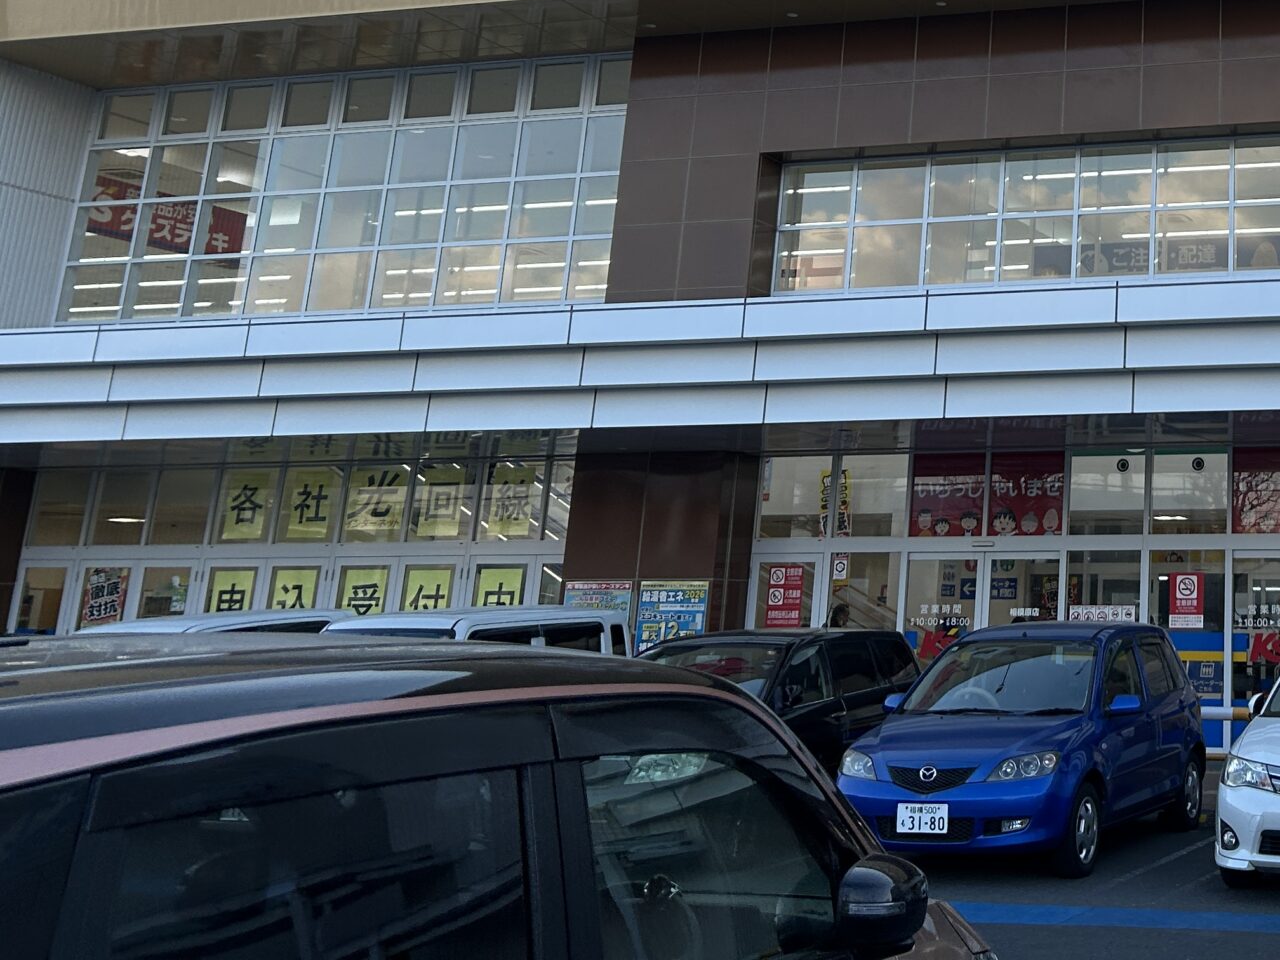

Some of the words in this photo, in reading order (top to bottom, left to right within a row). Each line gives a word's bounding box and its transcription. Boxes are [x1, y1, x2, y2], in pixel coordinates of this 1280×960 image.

[120, 209, 230, 253] ケズデキ
[230, 470, 532, 526] 各社光回線
[916, 477, 1061, 497] いらっしゃいませ
[908, 816, 945, 831] 31-80
